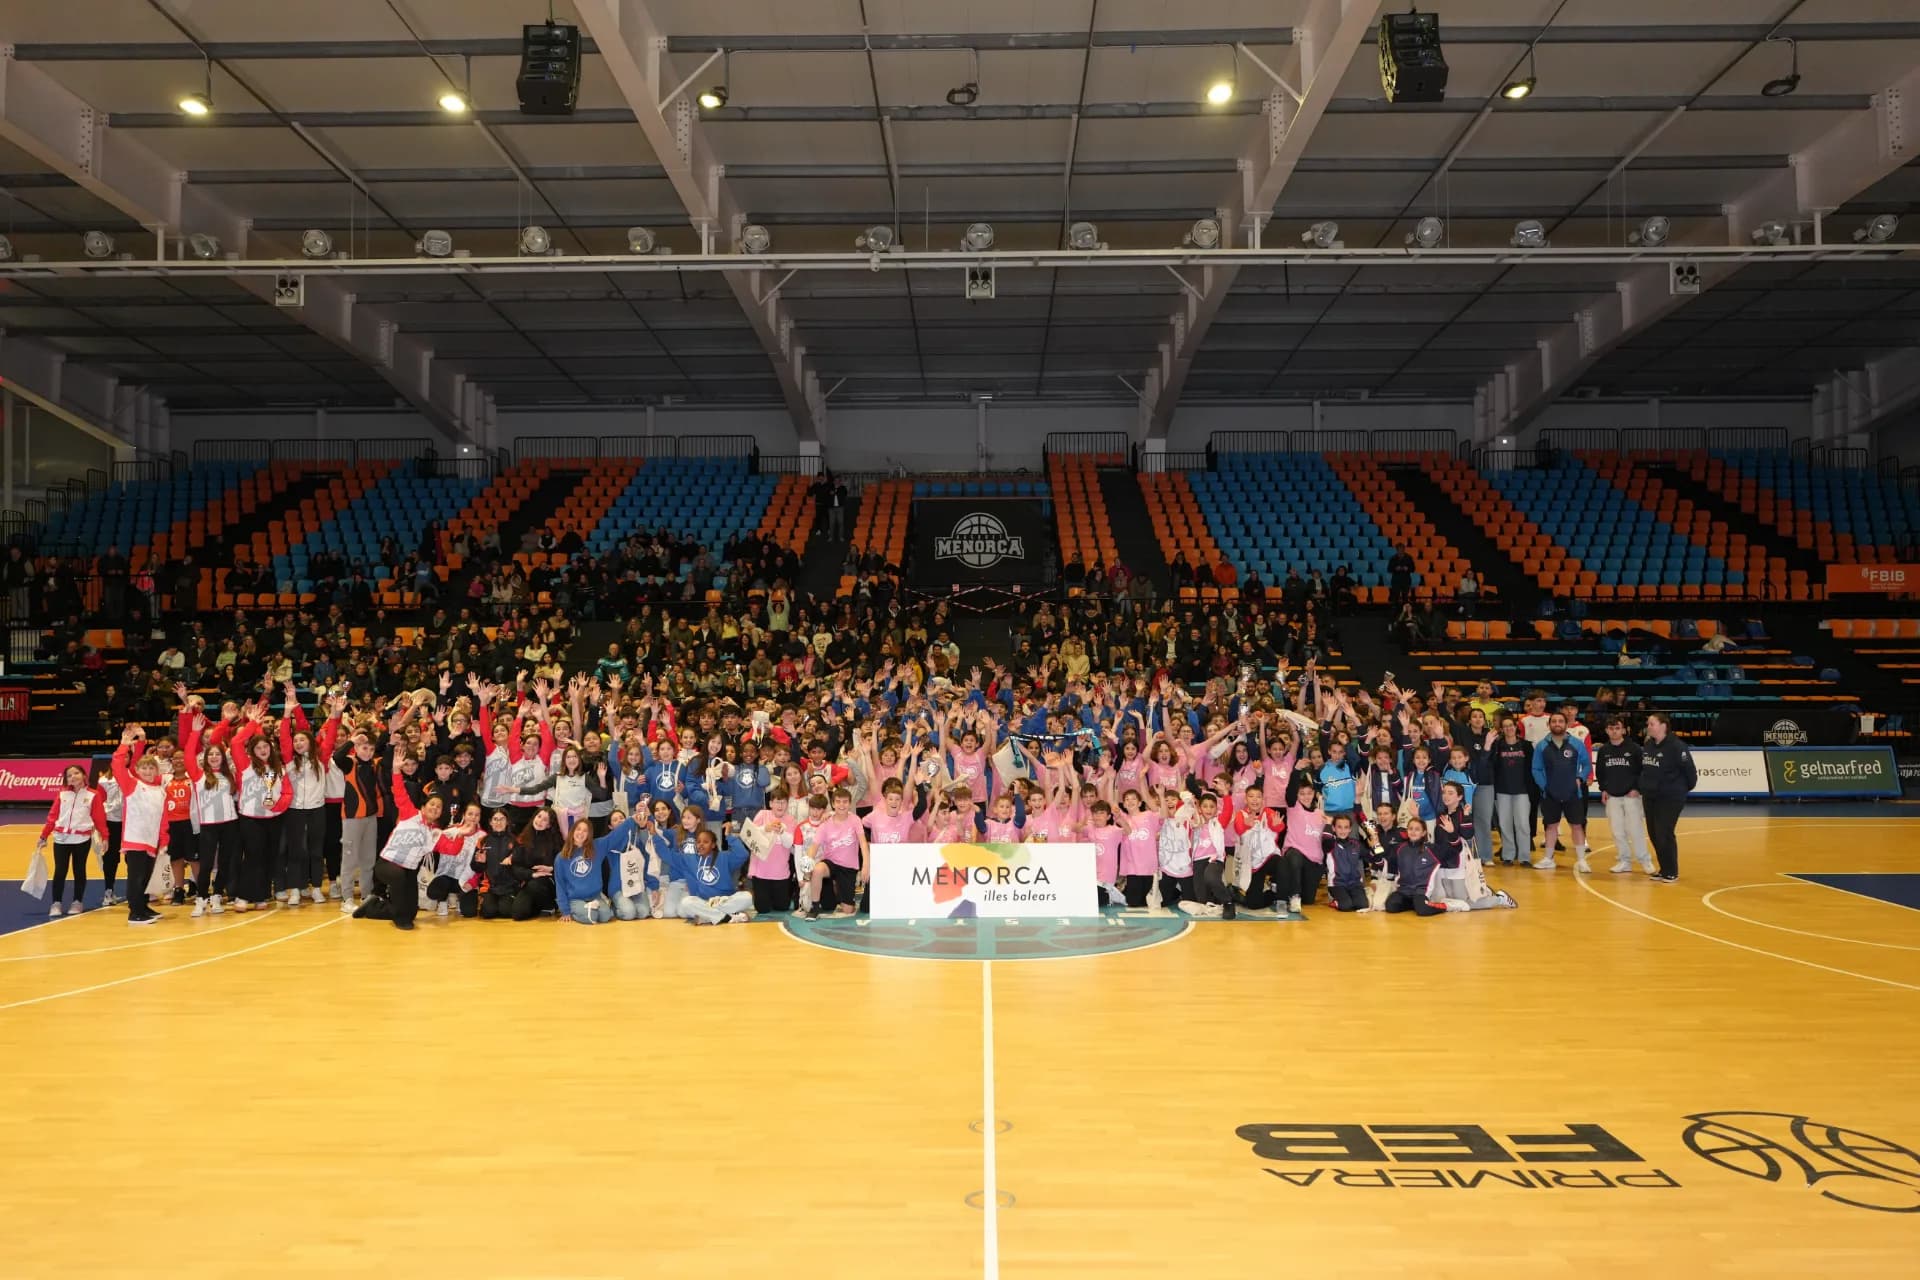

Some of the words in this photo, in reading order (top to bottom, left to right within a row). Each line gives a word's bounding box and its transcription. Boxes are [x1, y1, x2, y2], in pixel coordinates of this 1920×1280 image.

[937, 539, 1021, 556] MENORCA
[1870, 570, 1905, 582] FBIB
[1765, 732, 1807, 742] MENORCA
[1696, 766, 1753, 777] rascenter
[1800, 759, 1882, 779] gelmarfred
[173, 788, 185, 798] 10
[911, 866, 1051, 886] MENORCA
[984, 890, 1008, 902] illes
[1012, 890, 1057, 902] balears
[1262, 1167, 1682, 1189] PRIMERA
